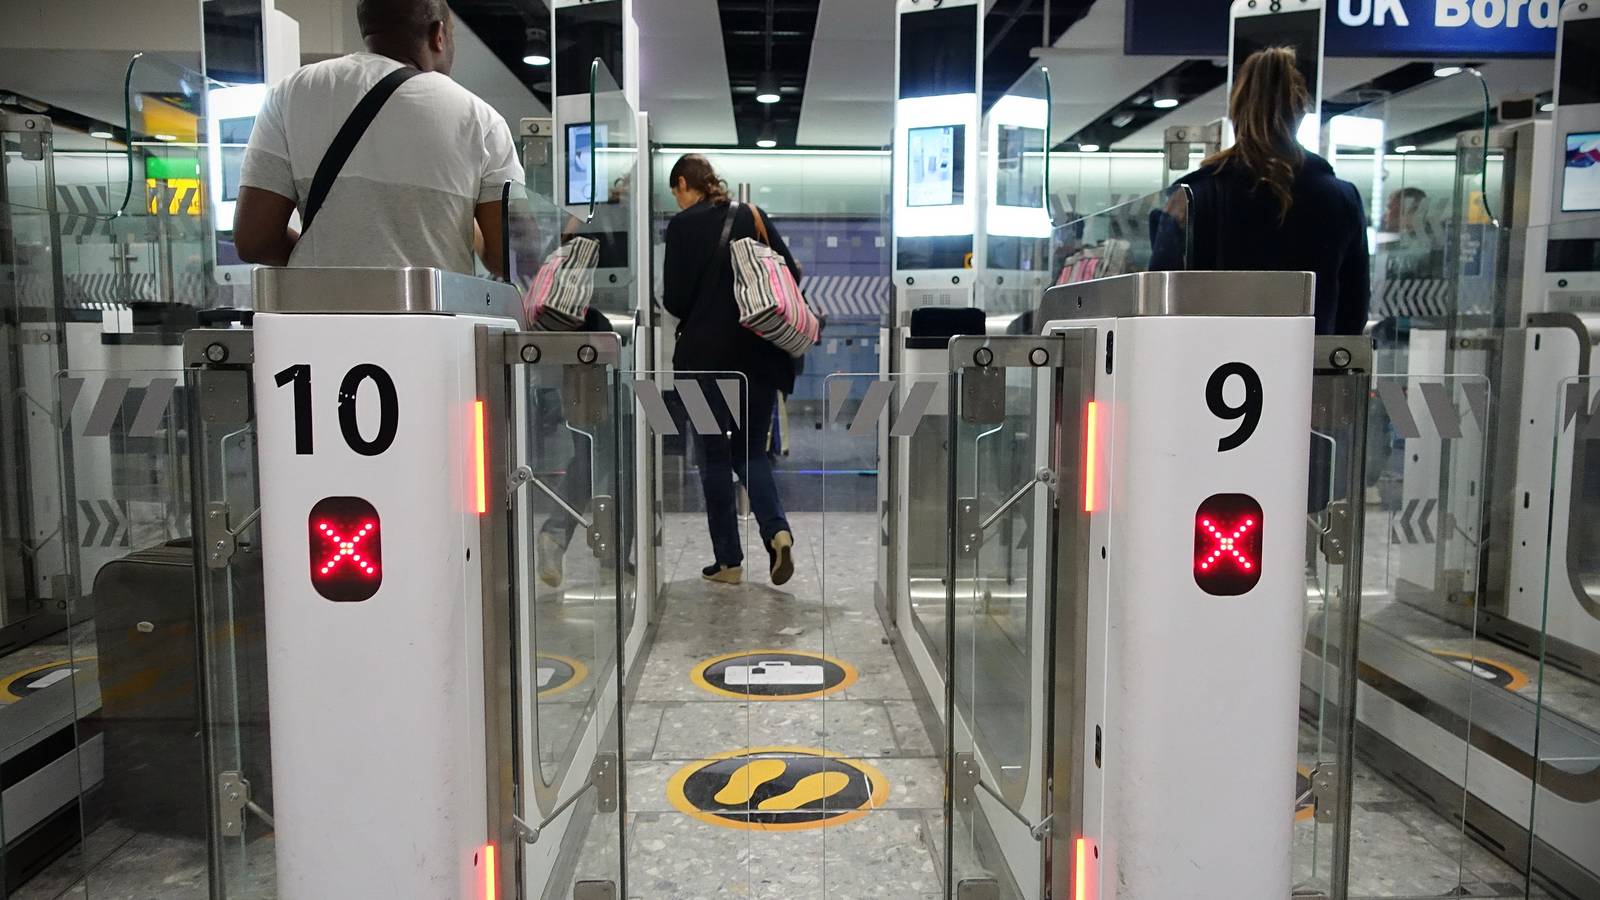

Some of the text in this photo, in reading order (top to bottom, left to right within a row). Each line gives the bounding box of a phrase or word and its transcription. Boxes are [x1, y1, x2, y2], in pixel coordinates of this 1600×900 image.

[1338, 0, 1409, 26] UK
[274, 363, 399, 456] 10
[1205, 362, 1263, 452] 9
